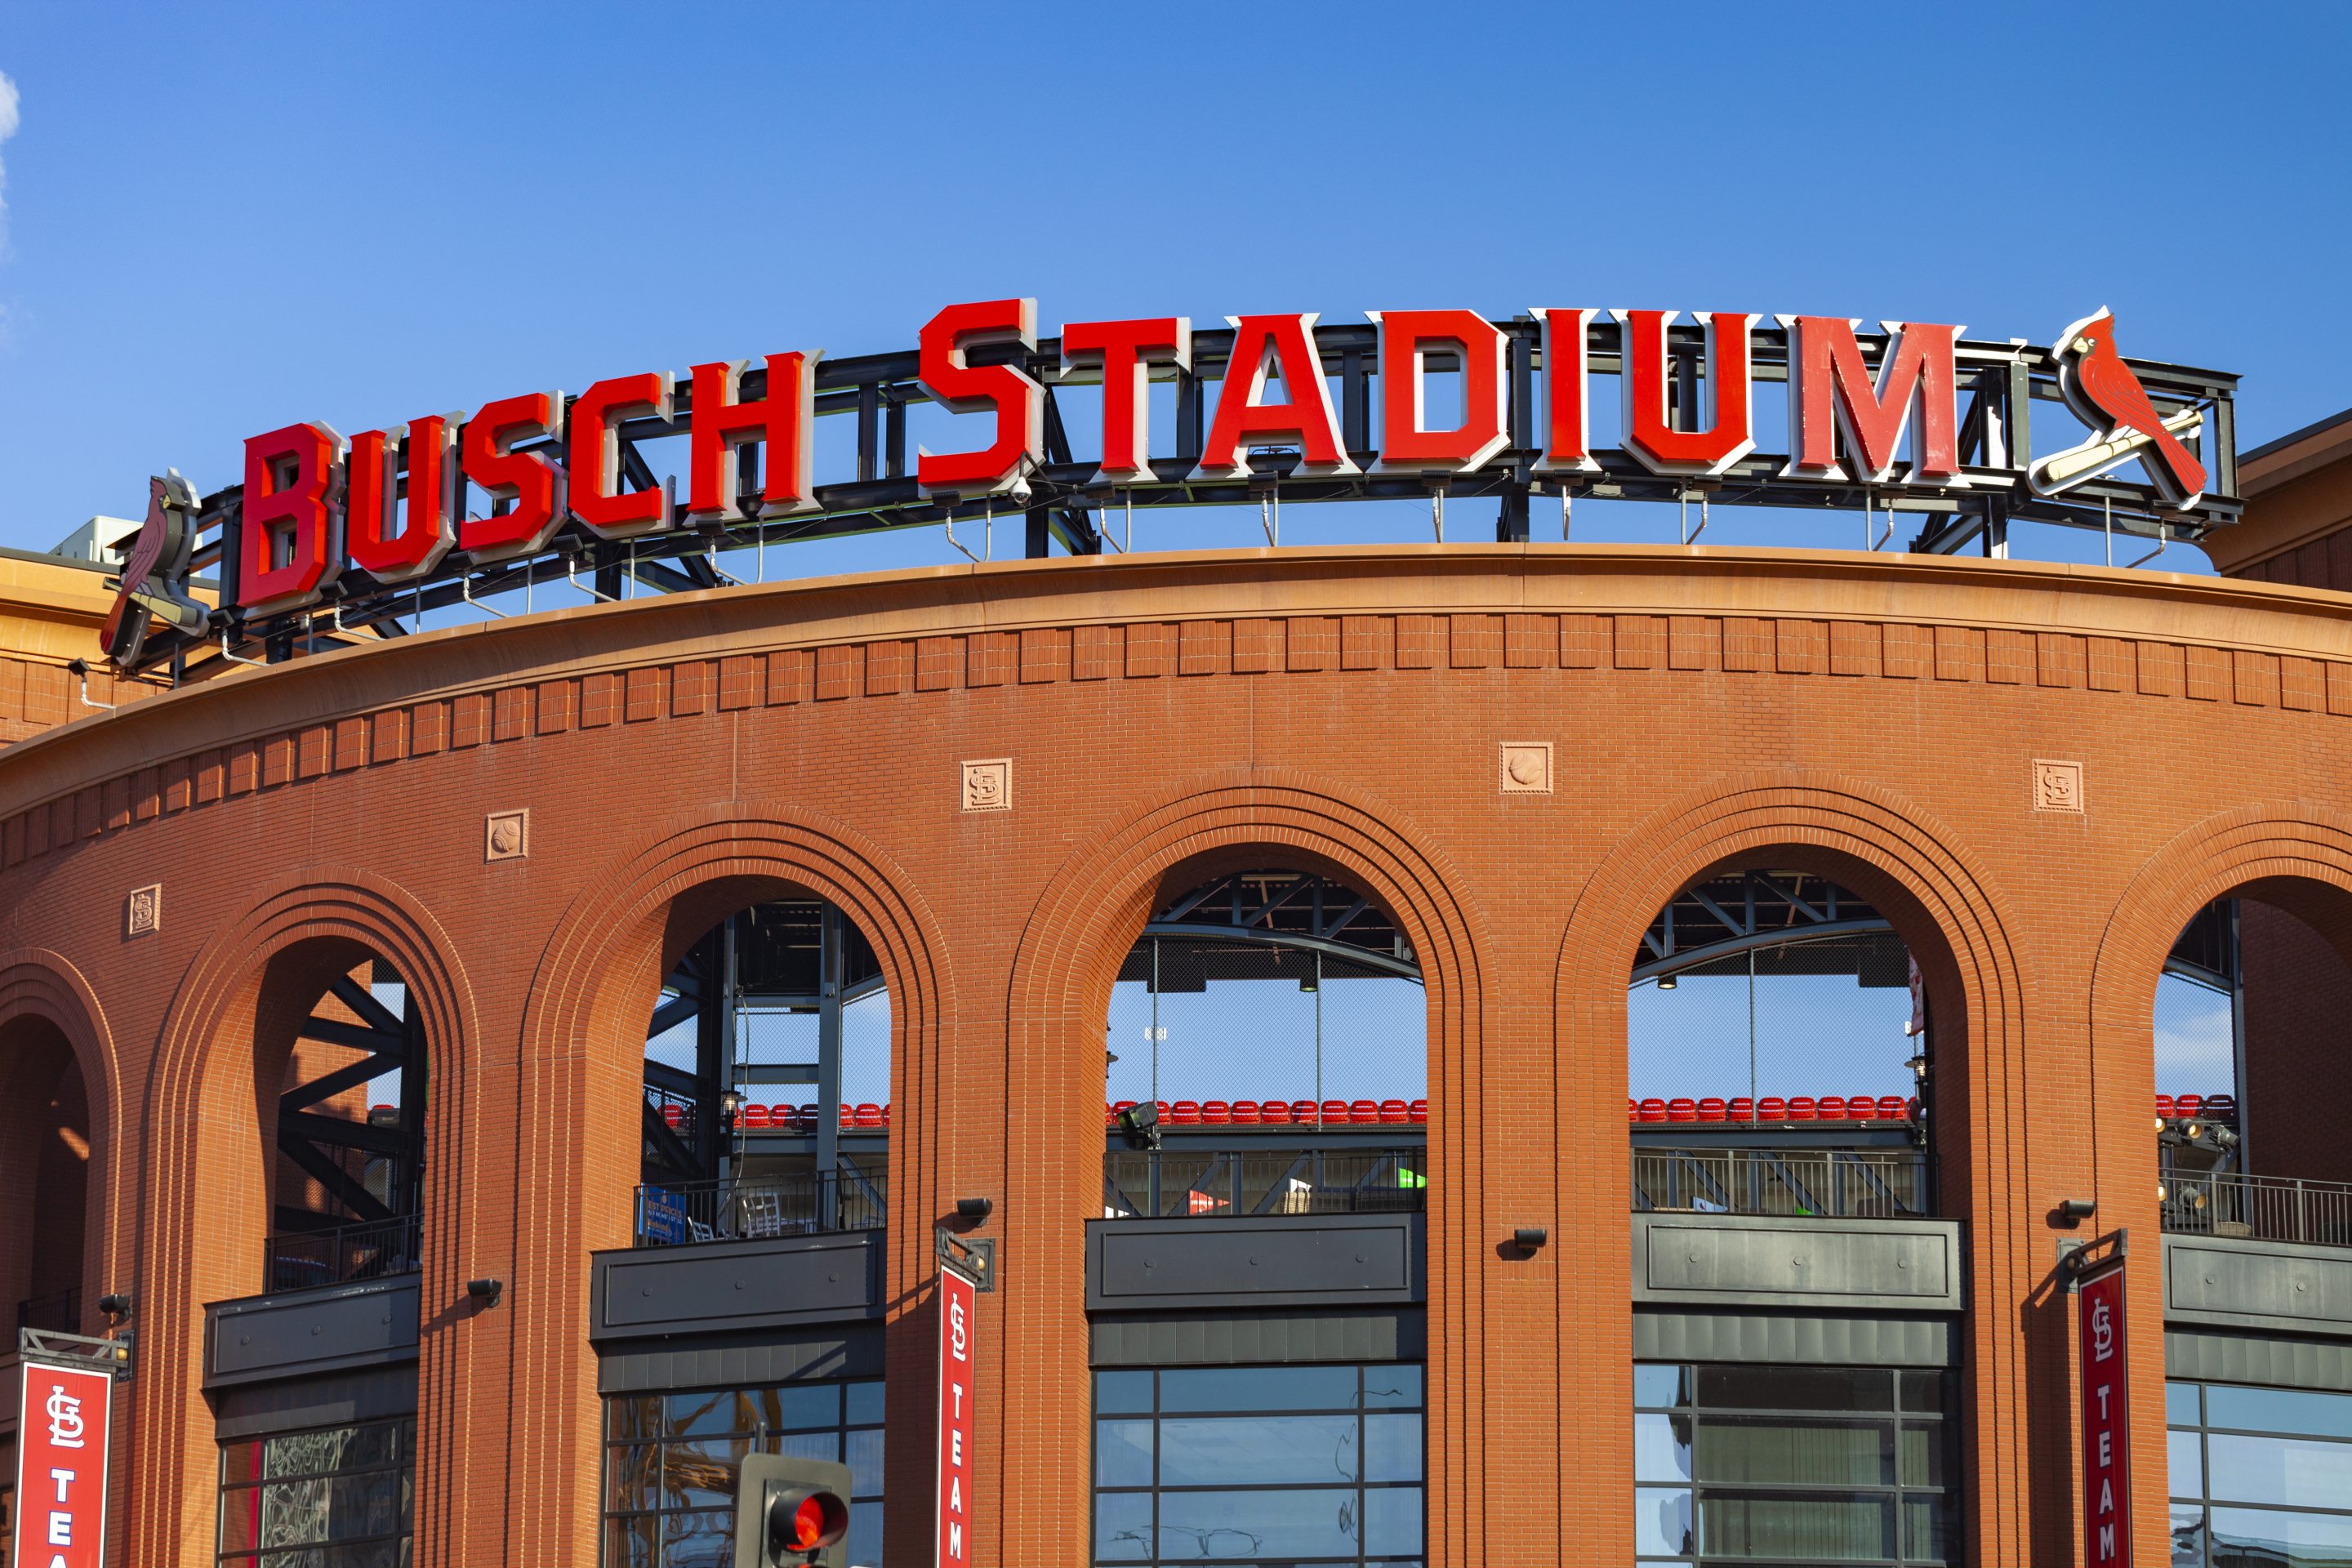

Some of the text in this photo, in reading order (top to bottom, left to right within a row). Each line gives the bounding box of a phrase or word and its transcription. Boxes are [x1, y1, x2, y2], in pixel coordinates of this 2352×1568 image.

[235, 296, 1971, 621] BUSCH STADIUM
[951, 1382, 963, 1561] TEAM
[2097, 1383, 2115, 1561] TEAM
